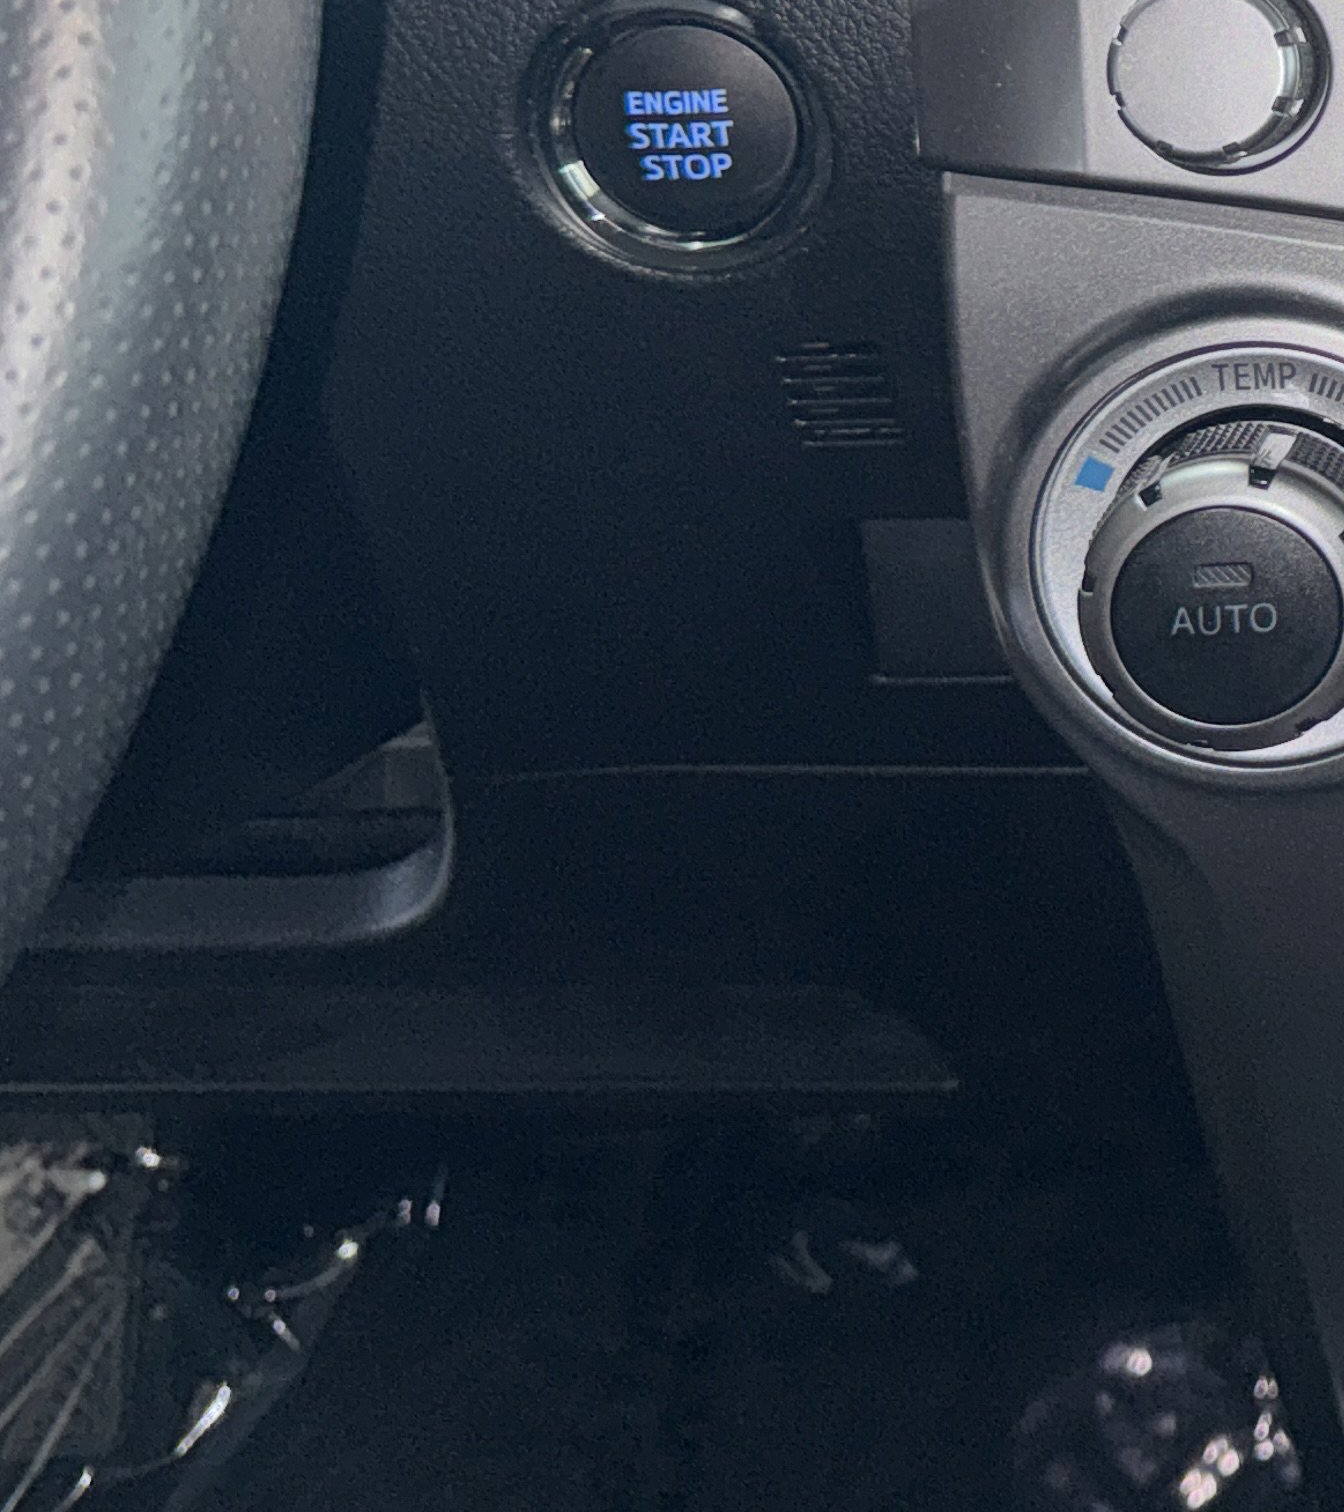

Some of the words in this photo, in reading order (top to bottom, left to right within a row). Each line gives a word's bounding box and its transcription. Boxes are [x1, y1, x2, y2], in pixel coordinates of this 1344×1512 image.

[624, 88, 729, 116] ENGINE
[626, 119, 734, 150] START
[640, 152, 733, 182] STOP
[1211, 361, 1297, 392] TEMP
[1170, 602, 1279, 637] AUTO
